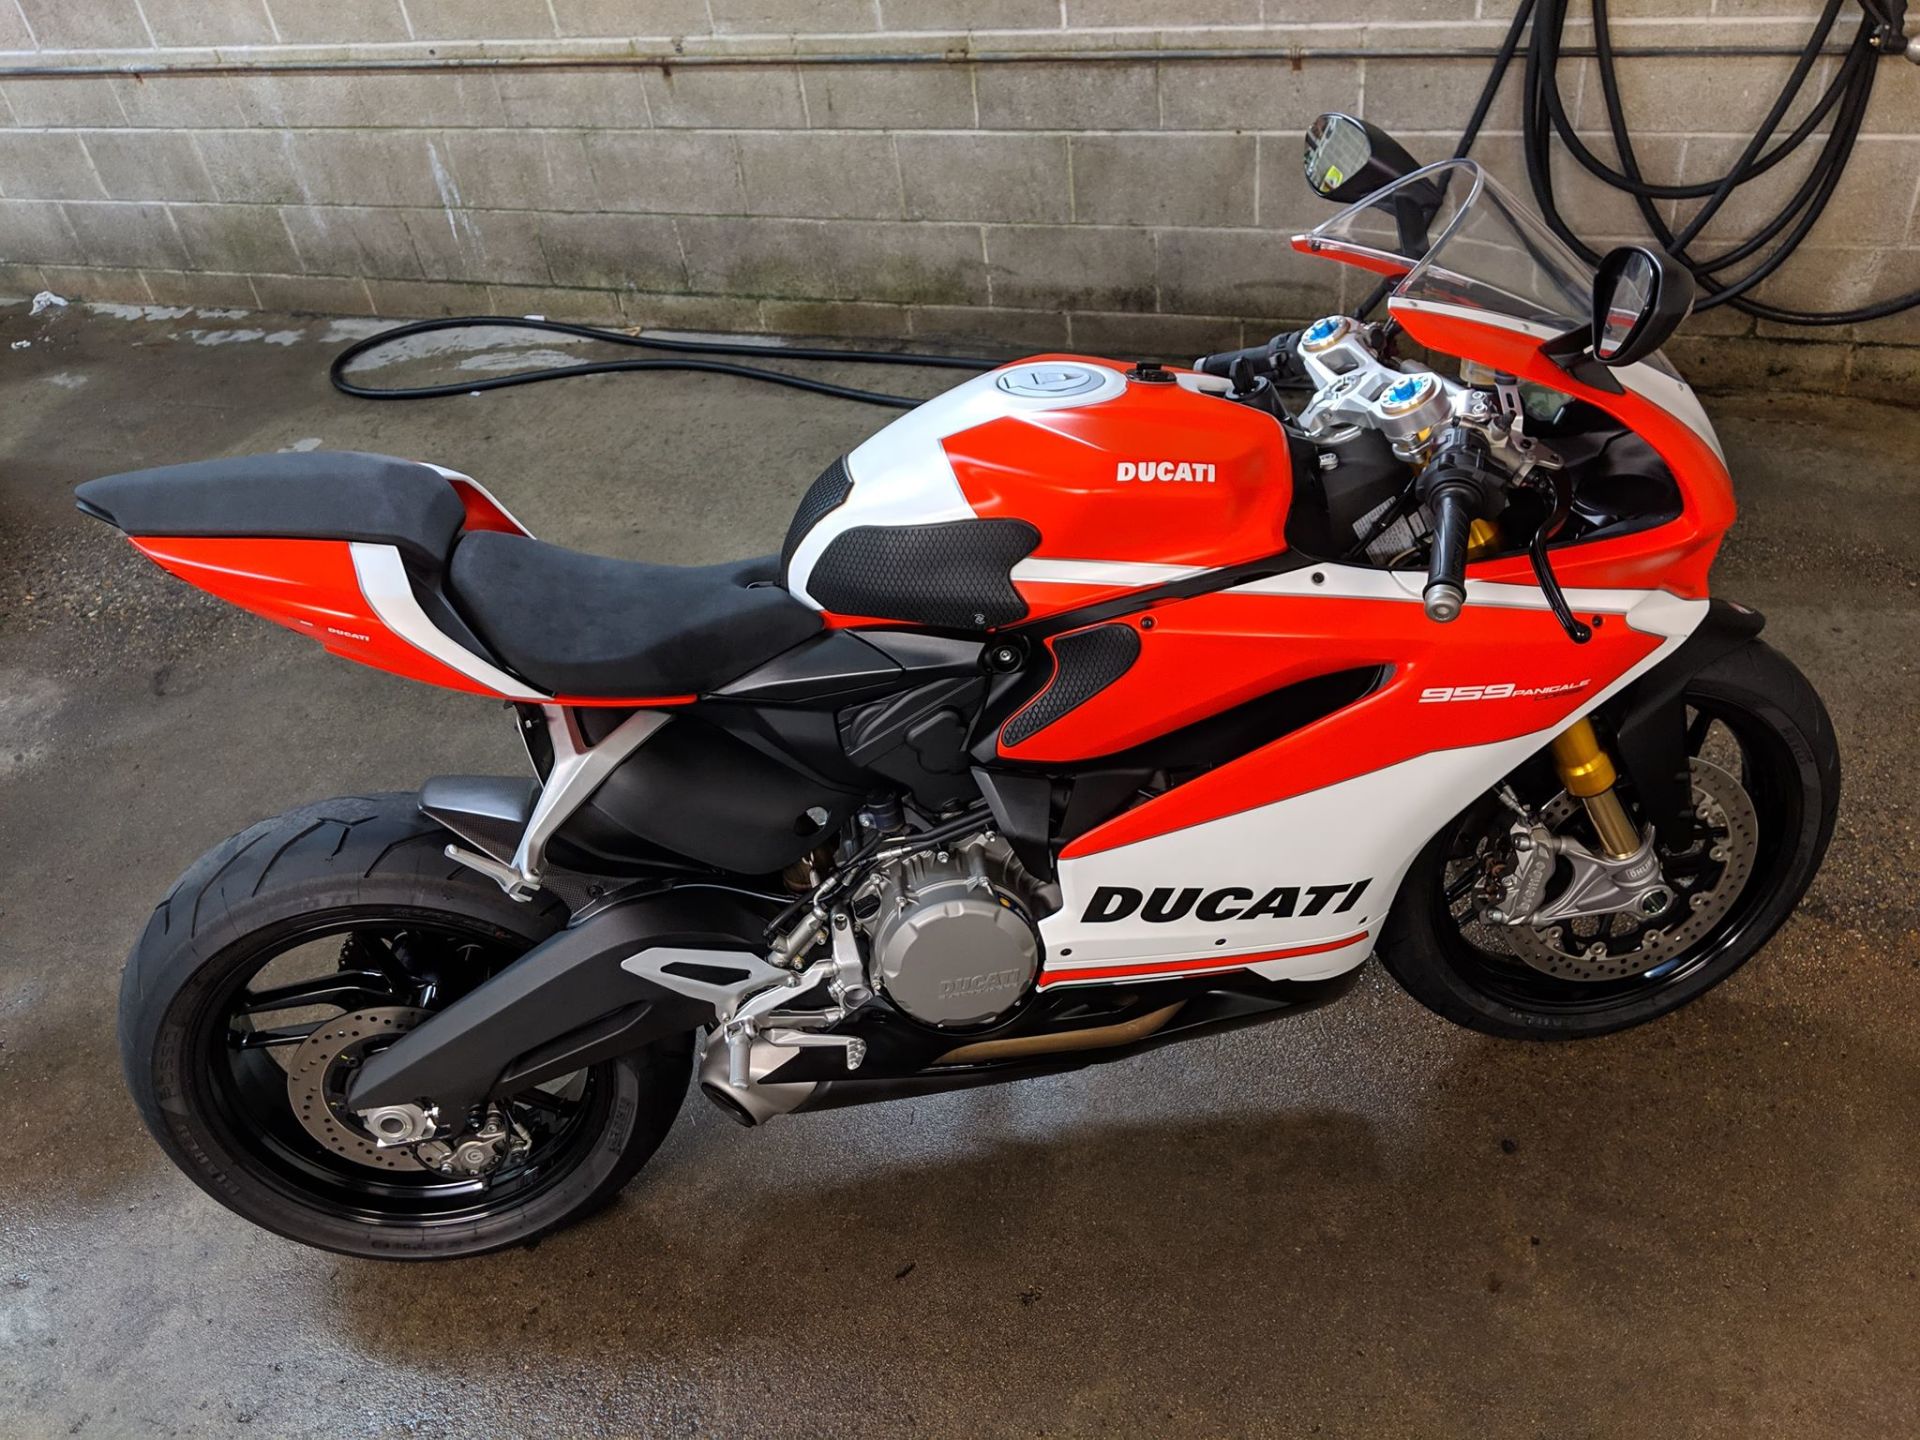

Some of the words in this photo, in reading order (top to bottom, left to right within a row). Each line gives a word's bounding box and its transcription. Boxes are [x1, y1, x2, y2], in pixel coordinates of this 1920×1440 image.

[1116, 461, 1216, 483] DUCATI
[327, 627, 370, 641] DUCATI
[1418, 683, 1516, 703] 959
[1080, 877, 1374, 923] DUCATI
[940, 968, 1020, 993] DUCATI
